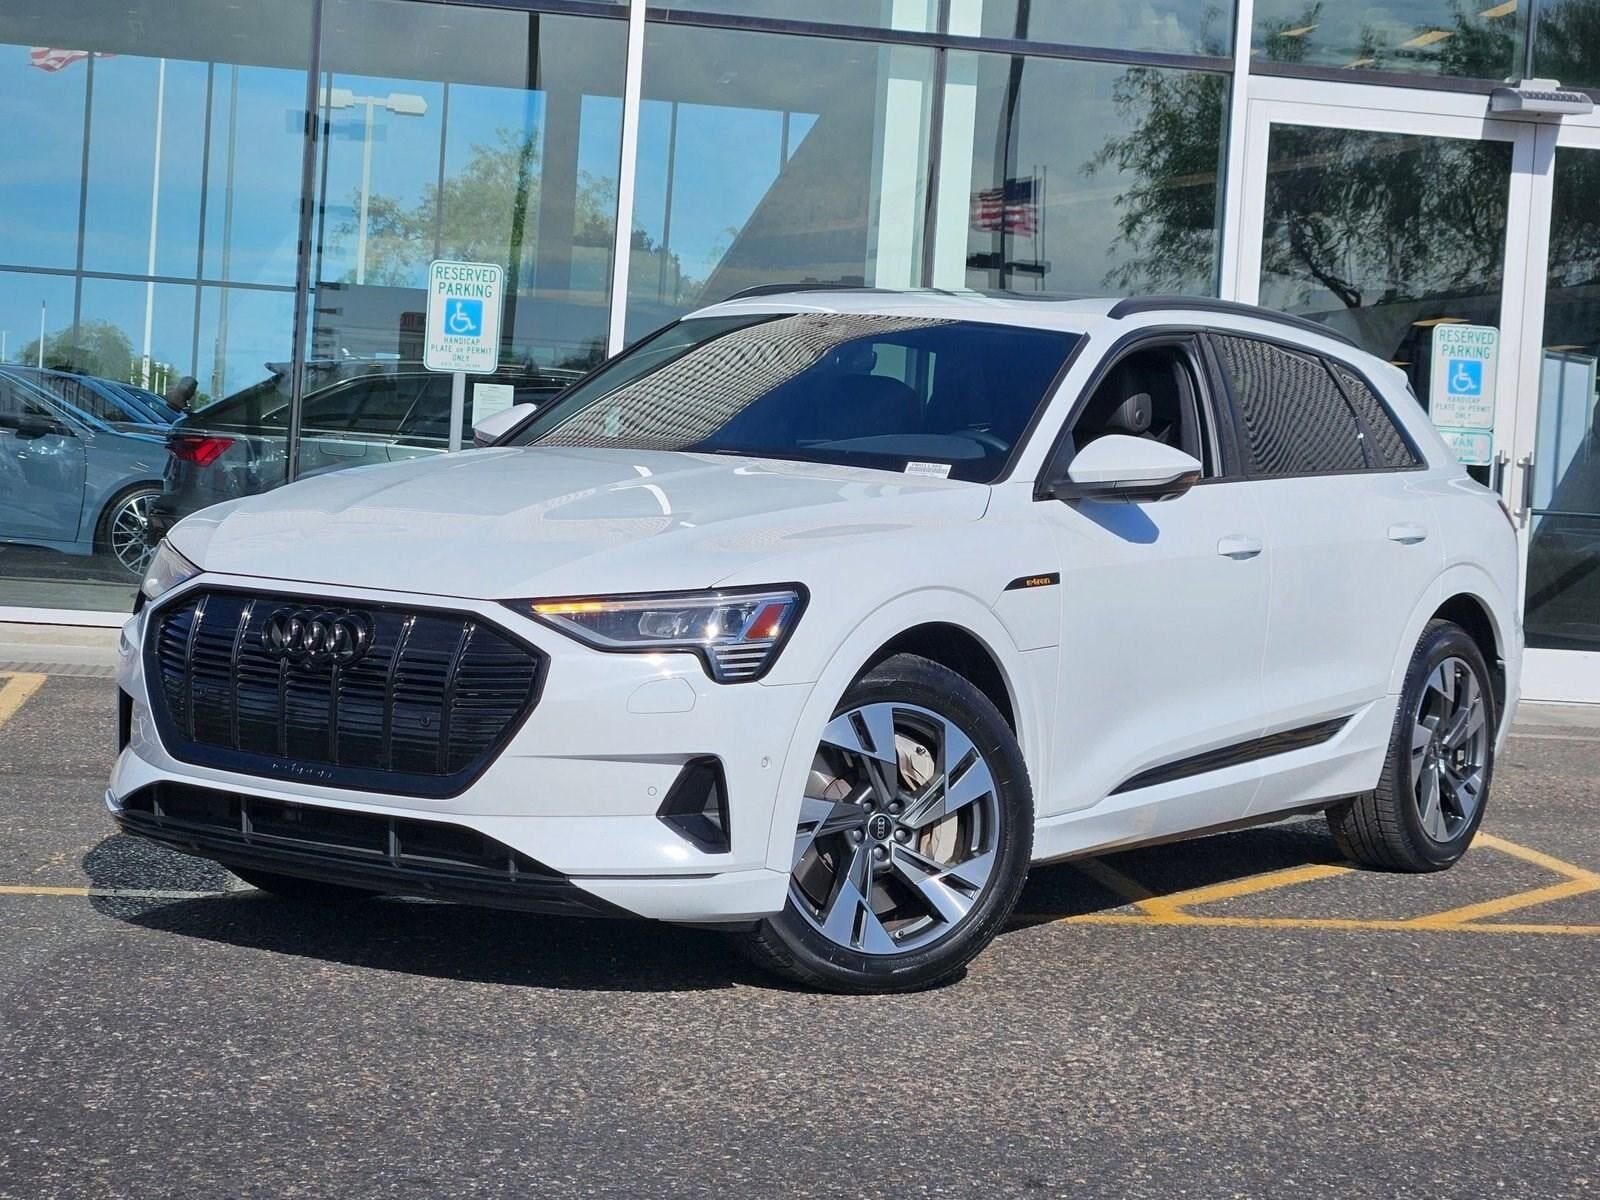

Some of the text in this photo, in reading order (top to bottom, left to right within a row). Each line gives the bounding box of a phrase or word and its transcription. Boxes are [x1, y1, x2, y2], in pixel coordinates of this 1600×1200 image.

[435, 265, 497, 283] RESERVED
[438, 281, 493, 298] PARKING
[443, 336, 481, 345] HANDICAP
[1439, 329, 1495, 345] RESERVED
[431, 343, 452, 353] PLATE
[466, 346, 493, 355] PERMIT
[1442, 343, 1490, 360] PARKING
